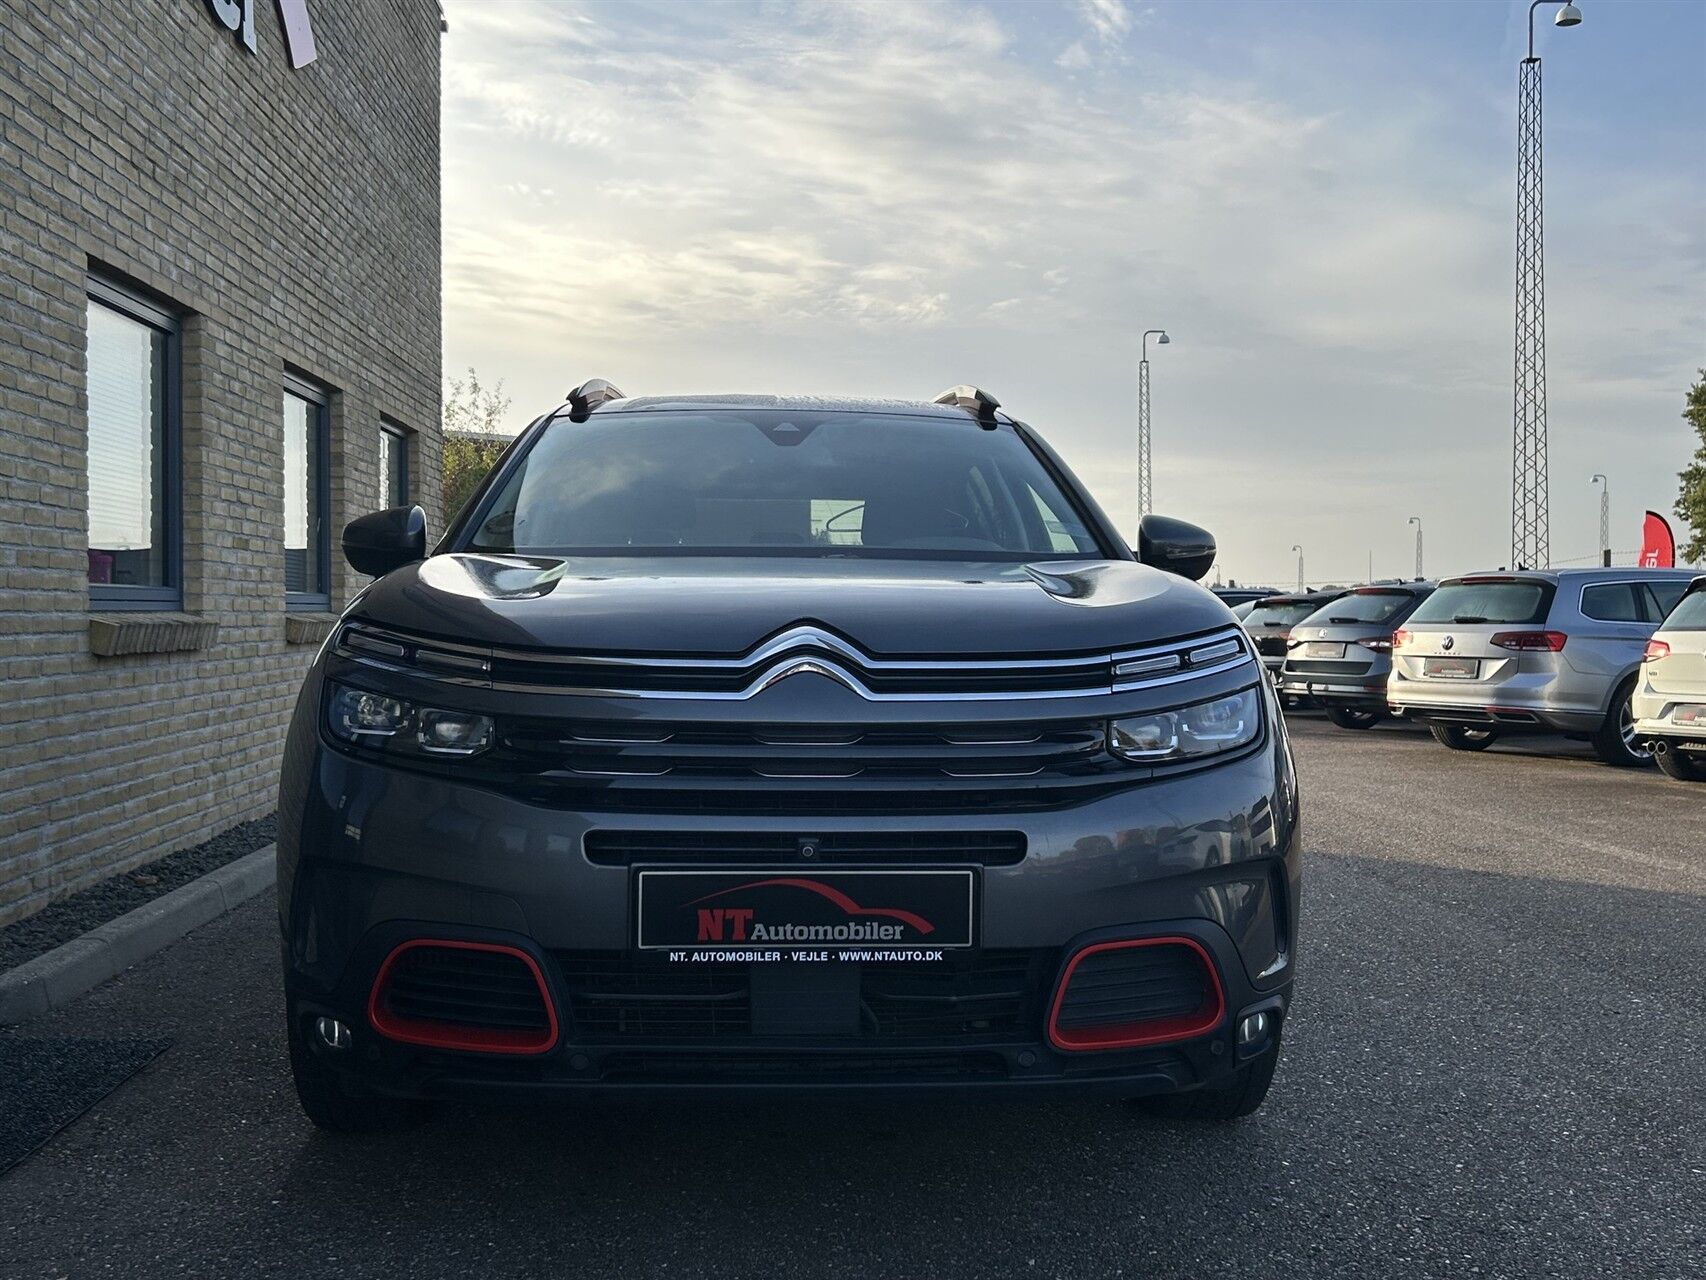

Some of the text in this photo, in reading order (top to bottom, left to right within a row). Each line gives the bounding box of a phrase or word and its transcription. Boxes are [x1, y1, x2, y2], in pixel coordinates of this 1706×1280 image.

[697, 909, 904, 941] NT Automobiler
[669, 951, 943, 962] NT. AUTOMOBILER VEJLE WWW.NTAUTO.DK
